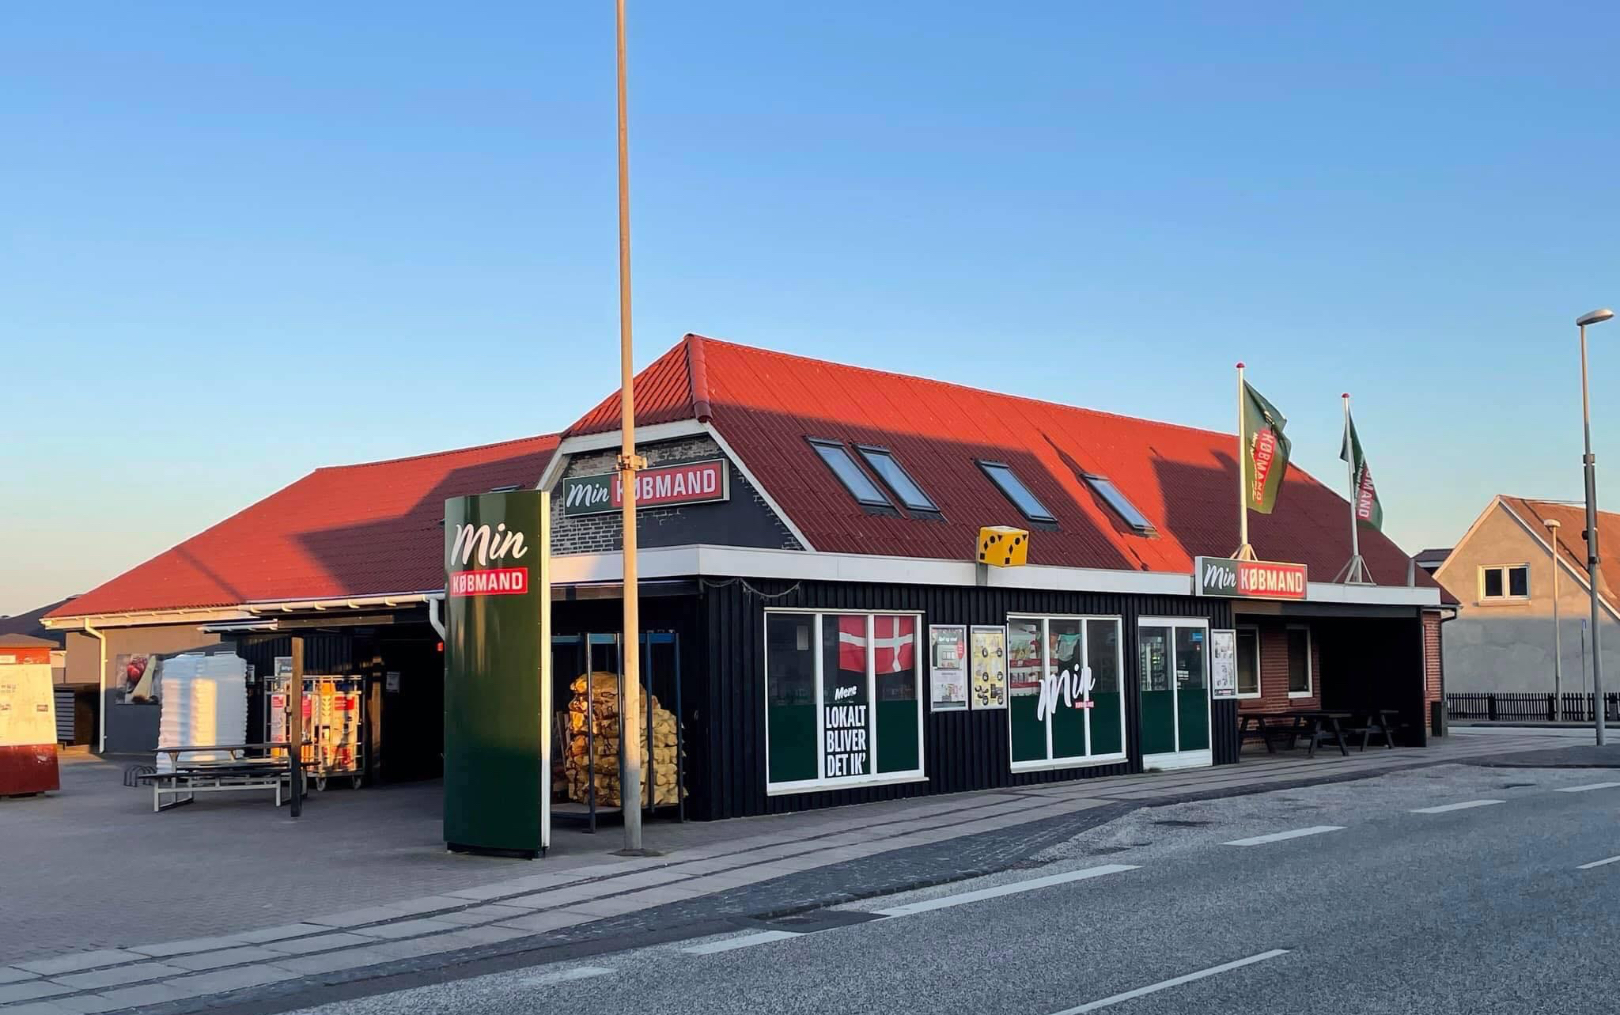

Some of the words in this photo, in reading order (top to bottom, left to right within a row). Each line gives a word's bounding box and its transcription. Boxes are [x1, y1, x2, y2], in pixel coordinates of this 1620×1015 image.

[1256, 433, 1275, 502] KØBMAND
[566, 483, 609, 508] Min
[451, 522, 528, 566] Min
[452, 572, 524, 595] KØBMAND
[1203, 563, 1237, 590] Min
[1241, 568, 1303, 593] KØBMAND
[834, 685, 858, 701] Mere
[1037, 663, 1096, 722] Min
[826, 705, 867, 729] LOKALT
[826, 729, 867, 753] BLIVER
[827, 754, 849, 777] DET
[851, 753, 866, 775] IK'
